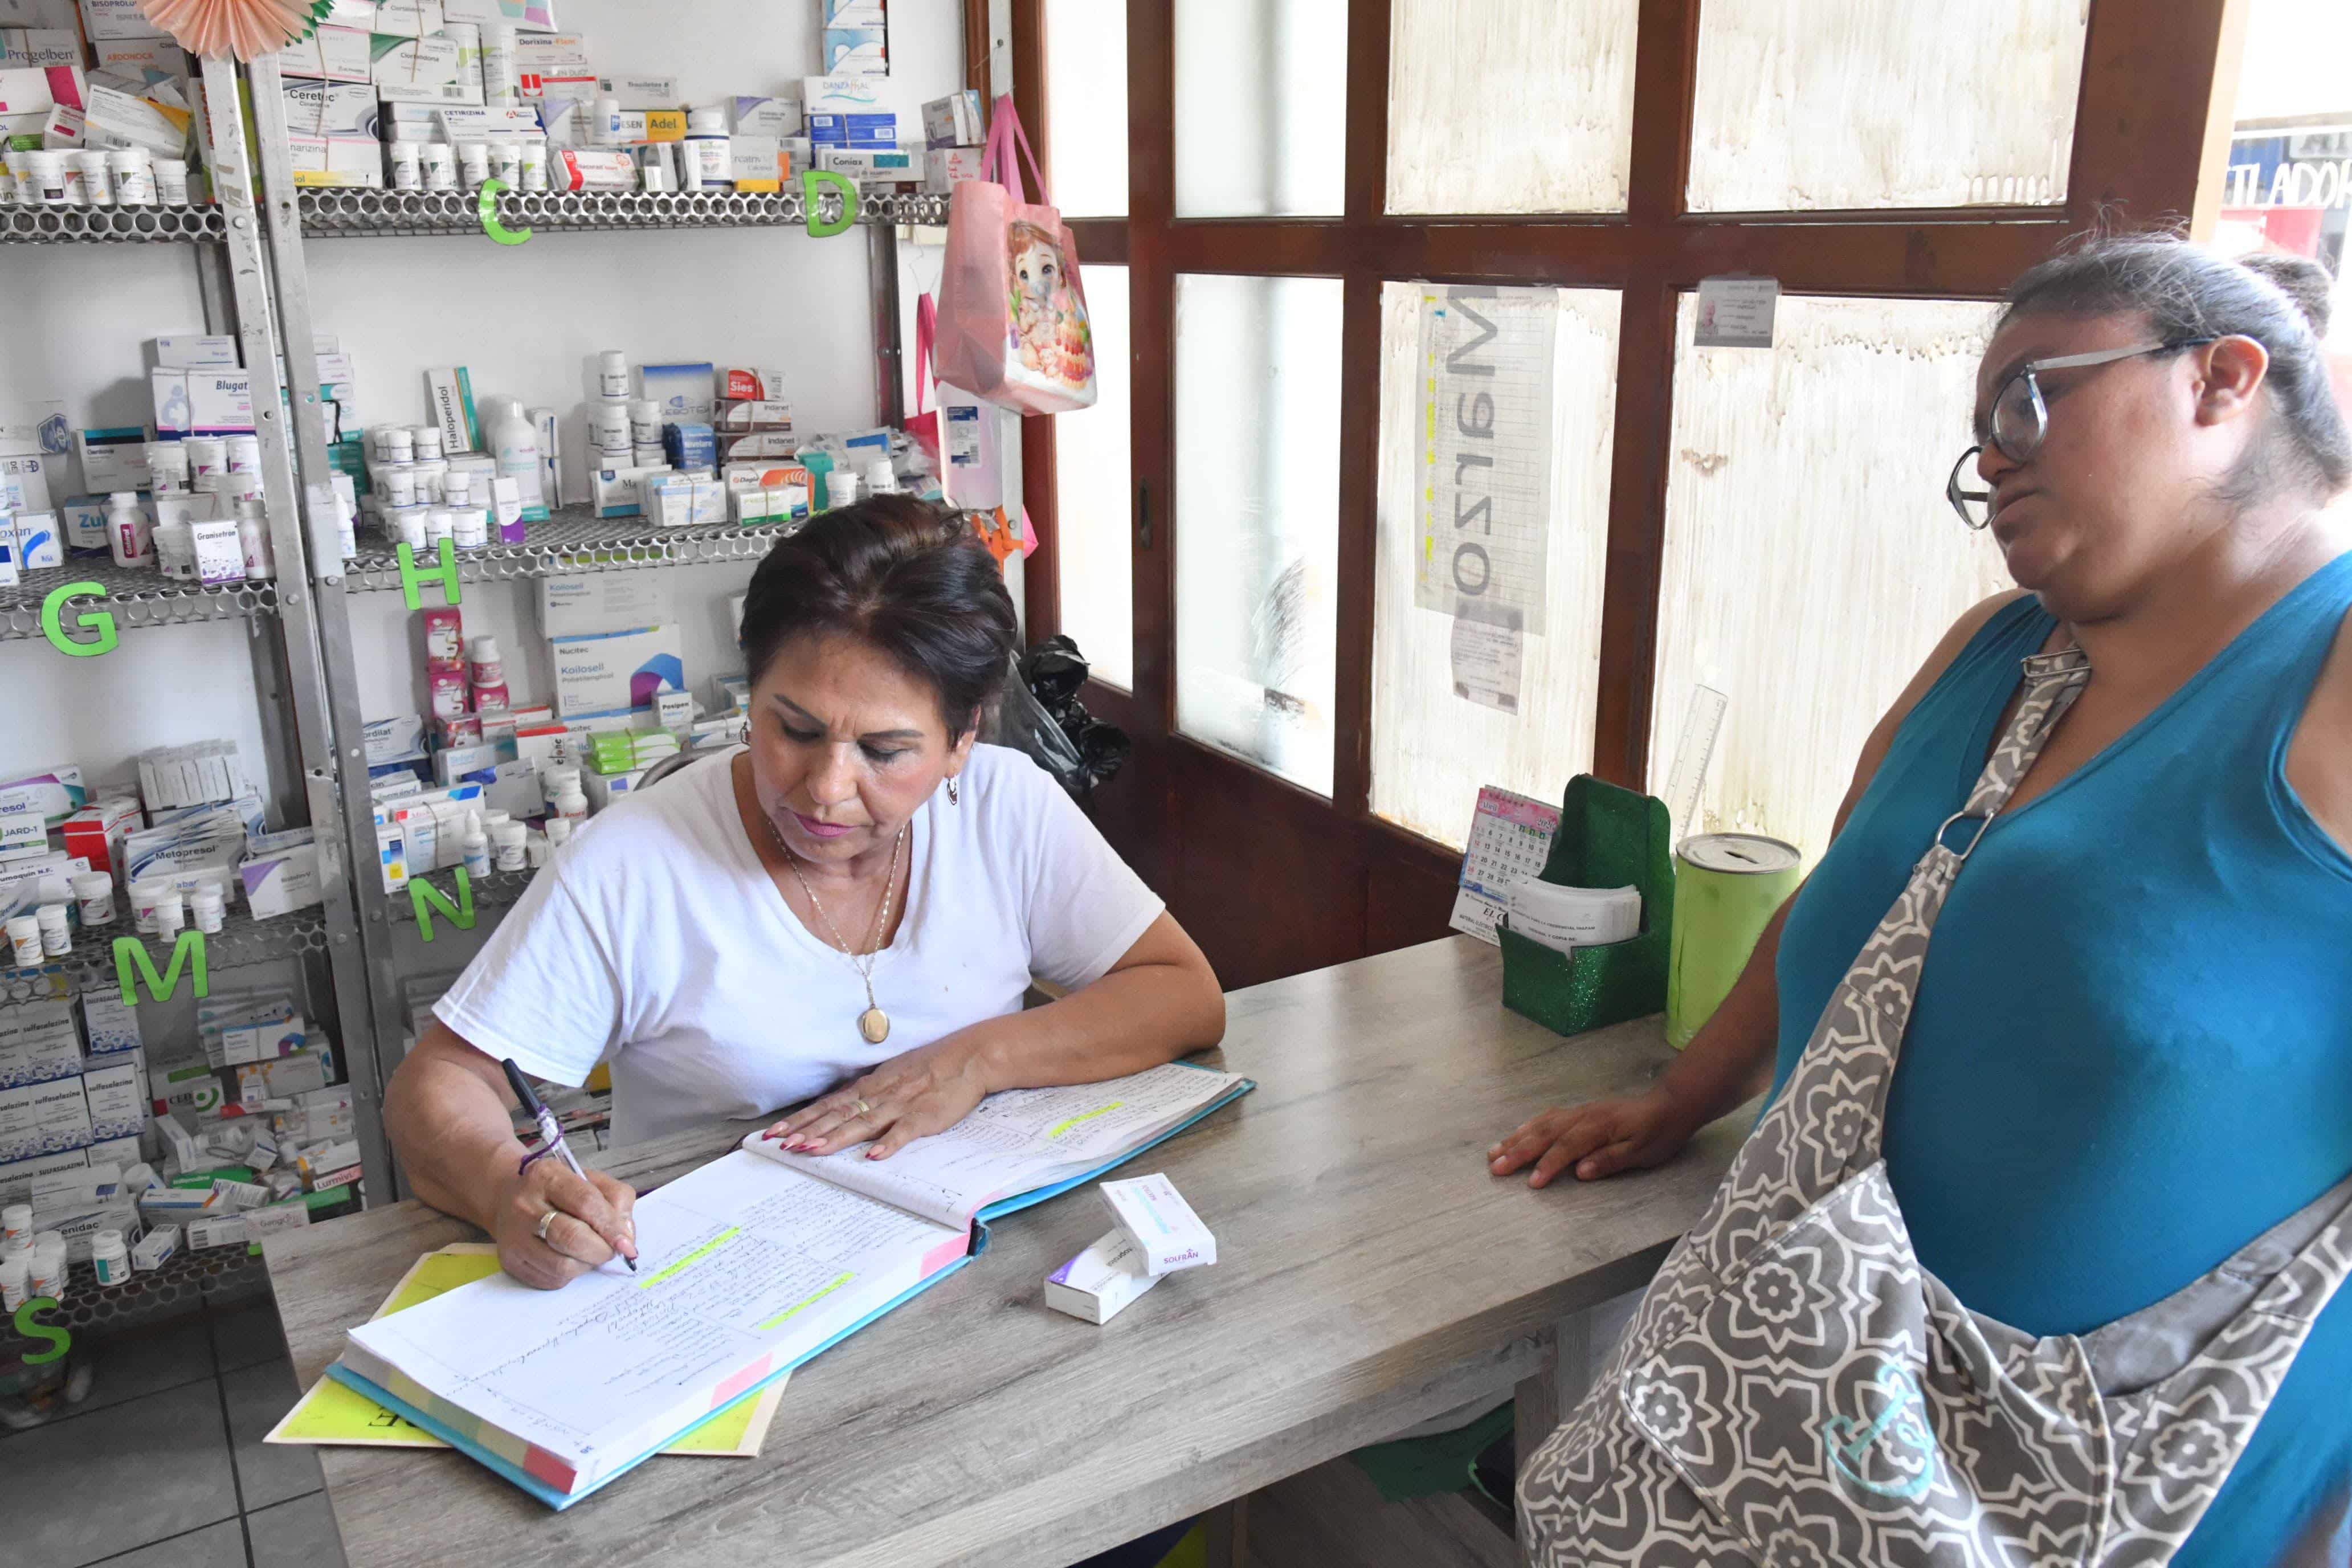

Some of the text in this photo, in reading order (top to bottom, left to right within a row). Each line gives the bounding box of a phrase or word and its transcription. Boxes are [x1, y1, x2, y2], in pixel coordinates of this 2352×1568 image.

[7, 48, 75, 63] Progelben
[650, 119, 676, 129] Adel
[478, 178, 533, 245] C
[802, 170, 857, 238] D
[216, 380, 248, 391] Blugat
[438, 386, 459, 449] Haloperidol
[197, 530, 236, 540] Granisetron
[398, 538, 460, 610] H
[41, 581, 119, 657] G
[559, 647, 589, 655] Nucitec
[155, 845, 217, 860] Metopresol
[409, 866, 476, 942] N
[113, 930, 209, 1006] M
[86, 994, 121, 1004] SULFASALAZ
[23, 1019, 69, 1032] sulfasalazina
[89, 1079, 133, 1092] sulfasalazina
[34, 1091, 80, 1105] sulfasalazina
[39, 1161, 85, 1176] SULFASALAZINA
[14, 1296, 72, 1365] S
